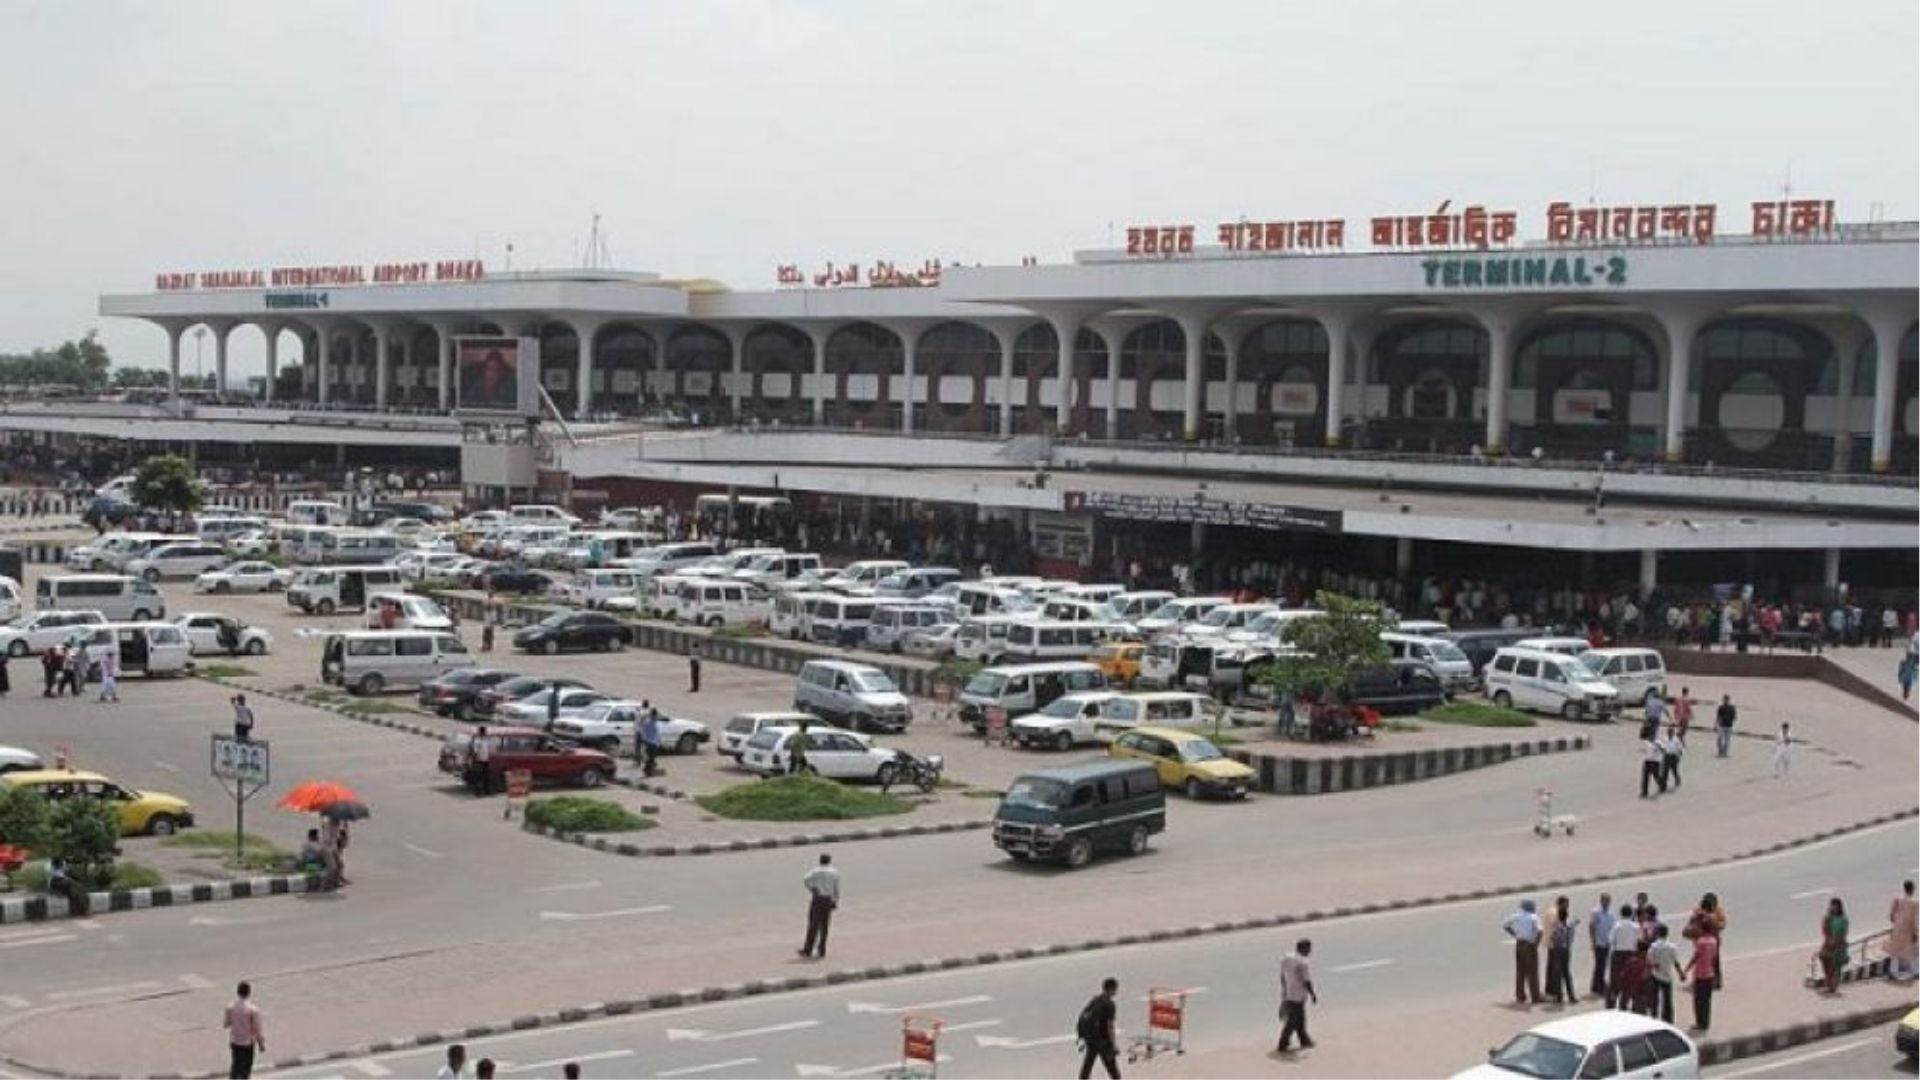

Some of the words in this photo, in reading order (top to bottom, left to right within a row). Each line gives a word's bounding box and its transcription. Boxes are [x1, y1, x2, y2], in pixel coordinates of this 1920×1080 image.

[1752, 200, 1835, 236] ঢাকা
[374, 262, 429, 282] AIRPORT
[1421, 256, 1627, 288] TERMINAL-2
